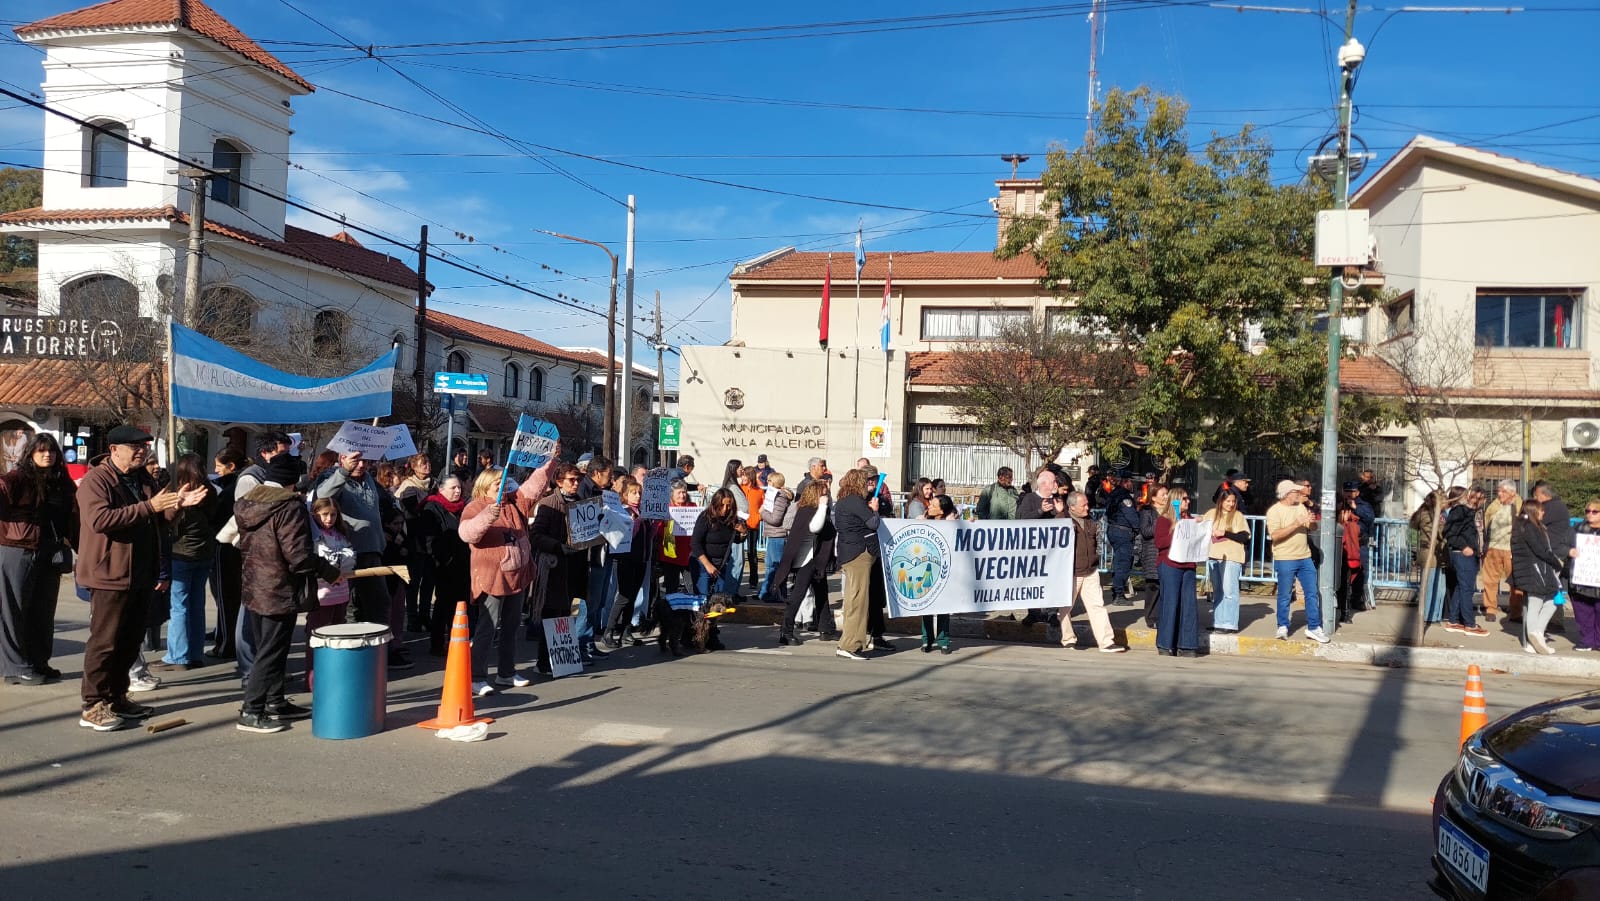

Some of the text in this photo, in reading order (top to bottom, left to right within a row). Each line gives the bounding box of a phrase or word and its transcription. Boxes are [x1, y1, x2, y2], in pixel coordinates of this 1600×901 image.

[2, 335, 14, 354] A
[23, 335, 88, 355] TORRE
[721, 423, 822, 436] MUNICIPALIDAD
[722, 437, 827, 449] VILLA ALLENDE
[576, 504, 596, 524] NO
[886, 528, 948, 558] MOVIMIENTO VECINAL
[954, 526, 1071, 552] MOVIMIENTO
[974, 555, 1049, 581] VECINAL
[973, 586, 1045, 603] VILLA ALLENDE
[552, 633, 573, 647] A LOS
[1440, 831, 1451, 857] AD
[1453, 842, 1469, 873] 856
[1471, 857, 1485, 888] LX
